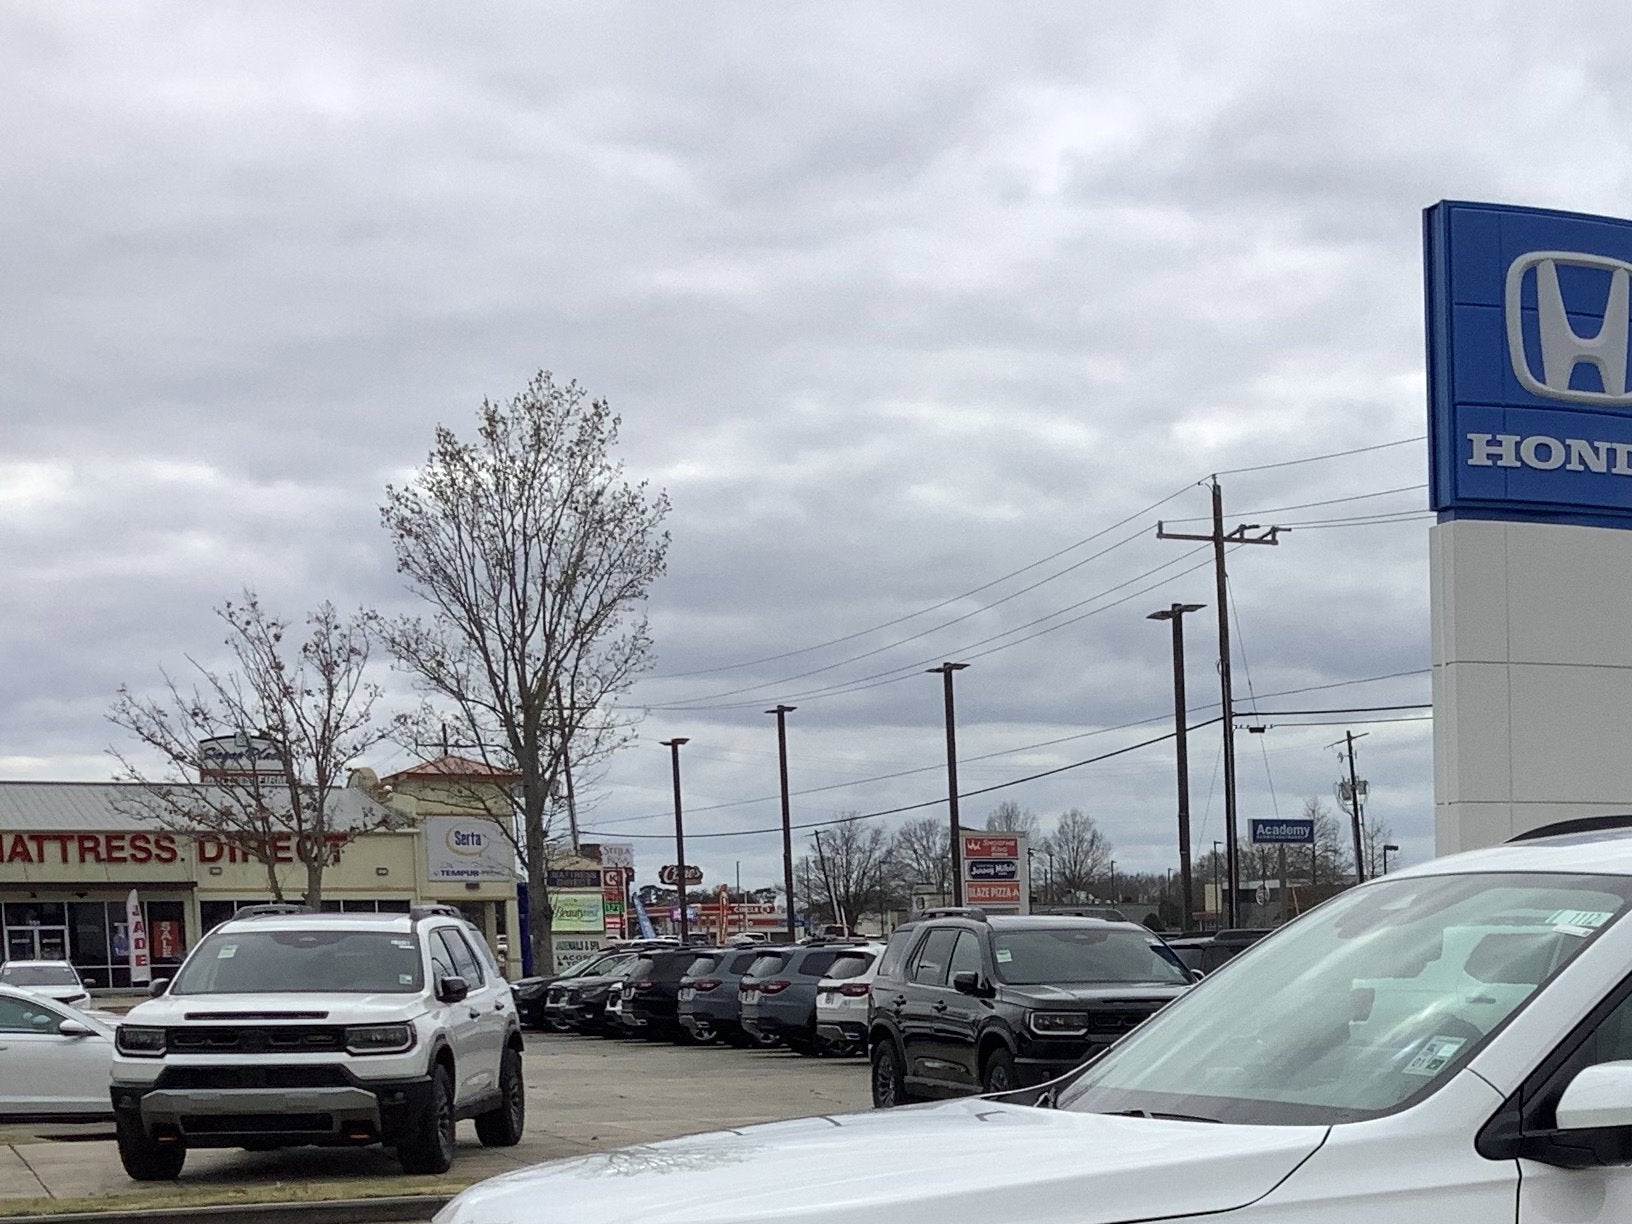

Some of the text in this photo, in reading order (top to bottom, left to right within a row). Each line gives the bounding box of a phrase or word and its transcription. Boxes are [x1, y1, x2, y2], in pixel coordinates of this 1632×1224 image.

[454, 830, 481, 846] Serta
[1256, 823, 1310, 838] Academy
[0, 834, 178, 863] ATTRESS
[991, 888, 1011, 897] PIZZA
[160, 921, 171, 958] SALE
